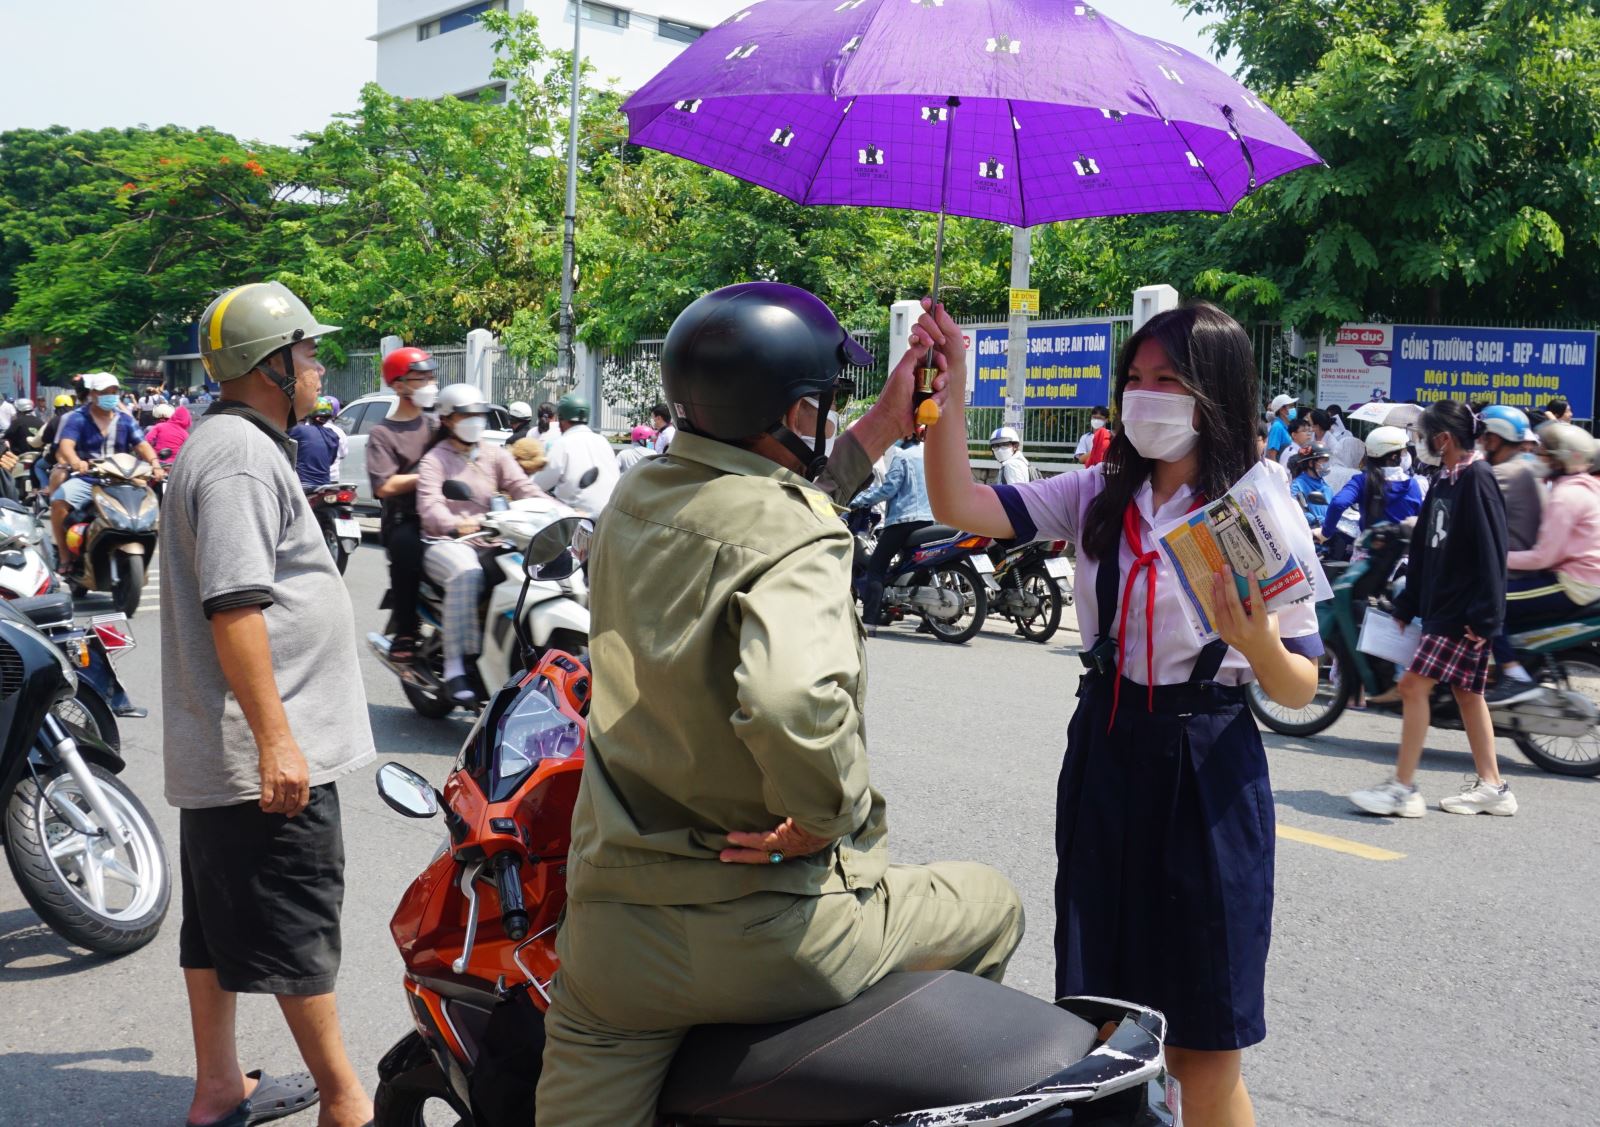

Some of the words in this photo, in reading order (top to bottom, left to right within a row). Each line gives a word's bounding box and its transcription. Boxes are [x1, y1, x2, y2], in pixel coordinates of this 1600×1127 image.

[1071, 336, 1082, 352] AN
[1084, 332, 1105, 352] TOÀN
[1361, 330, 1382, 344] dục
[1401, 331, 1430, 360] CỔNG
[1432, 336, 1473, 362] TRƯỜNG
[1476, 341, 1504, 366] SẠCH
[1513, 342, 1533, 367] ĐẸP
[1541, 343, 1557, 364] AN
[1559, 340, 1586, 366] TOÀN
[1073, 367, 1082, 379] xe
[1424, 369, 1448, 387] Một
[1450, 371, 1458, 386] ý
[1461, 371, 1489, 386] thức
[1492, 372, 1520, 388] giao
[1522, 373, 1560, 390] thông
